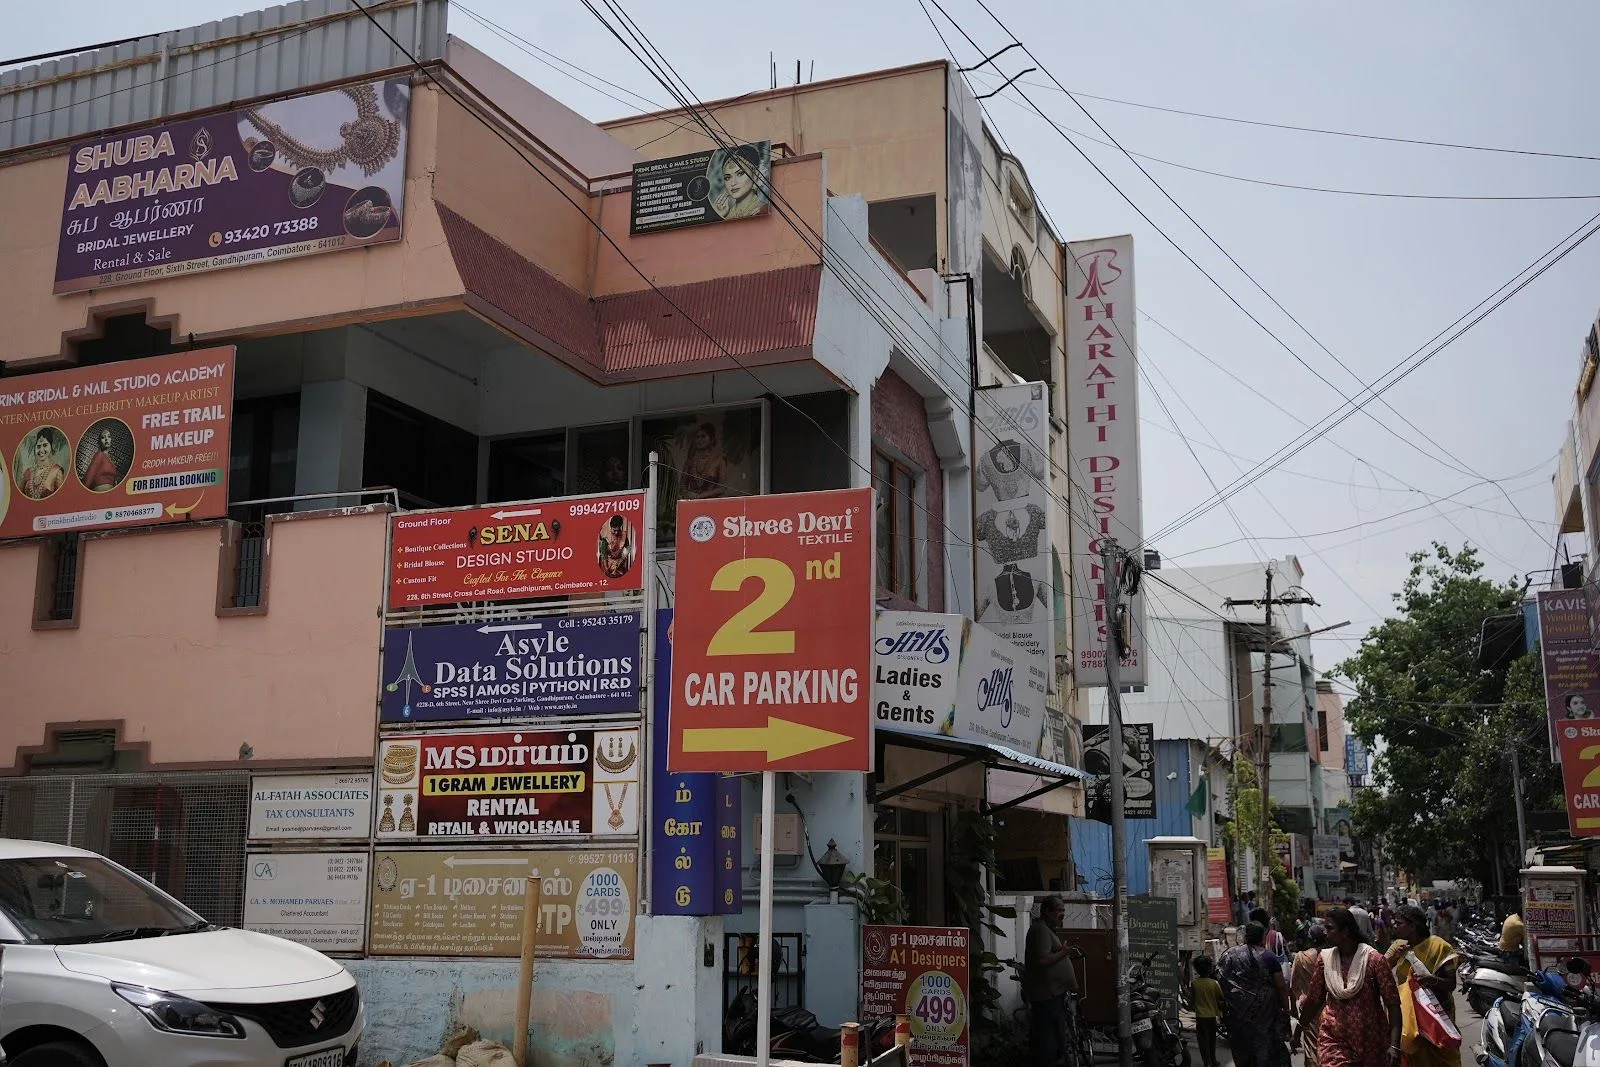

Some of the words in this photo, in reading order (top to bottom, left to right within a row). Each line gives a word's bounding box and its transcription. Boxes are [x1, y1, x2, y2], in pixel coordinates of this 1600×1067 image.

[74, 131, 175, 173] SHUBA
[68, 156, 238, 210] AABHARNA
[77, 233, 121, 254] BRIDAL
[122, 224, 194, 250] JEWELLERY
[225, 225, 269, 245] 93420
[273, 216, 318, 237] 73388
[93, 253, 131, 271] Rental
[133, 251, 143, 264] &
[147, 247, 171, 262] Sale
[115, 269, 141, 282] Ground
[143, 266, 164, 279] Floor,
[166, 261, 185, 275] Sixth
[186, 259, 210, 273] Street,
[212, 250, 263, 270] Gandhipuram,
[266, 243, 310, 260] Coimbatore
[0, 392, 25, 407] RINK
[28, 387, 69, 403] BRIDAL
[73, 384, 81, 398] &
[84, 382, 110, 397] NAIL
[113, 373, 160, 392] STUDIO
[164, 363, 225, 385] ACADEMY
[0, 408, 73, 425] TERNATIONAL
[76, 398, 134, 416] CELEBRITY
[136, 393, 178, 408] MAKEUP
[178, 386, 220, 402] ARTIST
[142, 411, 180, 429] FREE
[183, 404, 225, 424] TRAIL
[150, 428, 214, 451] MAKEUP
[142, 457, 166, 470] GROOM
[167, 454, 194, 466] MAKEUP
[133, 480, 148, 491] FOR
[149, 475, 178, 490] BRIDAL
[179, 472, 216, 486] BOOKING
[569, 499, 640, 517] 9994271009
[398, 519, 429, 529] Ground
[430, 517, 452, 527] Floor
[722, 515, 793, 539] Shree
[797, 508, 853, 534] Devi
[480, 522, 550, 546] SENA
[797, 533, 853, 546] TEXTILE
[404, 545, 432, 554] Boutique
[433, 541, 467, 552] Collections
[456, 552, 513, 569] DESIGN
[515, 546, 573, 564] STUDIO
[403, 561, 424, 569] Bridal
[424, 559, 445, 568] Blouse
[402, 576, 426, 585] Custom
[427, 575, 437, 583] Fit
[463, 573, 492, 587] Crafted
[531, 567, 563, 580] Elegance
[432, 591, 453, 600] Street,
[454, 589, 475, 598] Cross
[476, 588, 486, 596] Cut
[486, 587, 506, 597] Road,
[507, 584, 553, 596] Gandhipuram,
[554, 580, 593, 591] Coimbatore
[706, 557, 796, 656] 2
[806, 552, 841, 581] nd
[558, 619, 576, 629] Cell
[582, 616, 606, 628] 95243
[608, 614, 633, 625] 35179
[495, 630, 569, 660] Asyle
[1012, 632, 1033, 640] Blouse
[875, 629, 950, 665] Hills
[434, 662, 497, 685] Data
[505, 653, 633, 681] Solutions
[876, 665, 942, 689] Ladies
[433, 686, 468, 699] SPSS
[476, 683, 520, 697] AMOS
[530, 679, 592, 694] PYTHON
[600, 677, 631, 690] R&D
[684, 672, 735, 707] CAR
[743, 668, 858, 706] PARKING
[902, 690, 911, 701] &
[977, 666, 1014, 729] Hills
[877, 701, 935, 725] Gents
[423, 746, 477, 770] MS
[491, 774, 581, 791] JEWELLERY
[255, 791, 301, 801] AL-FATAH
[303, 789, 369, 800] ASSOCIATES
[265, 809, 283, 819] TAX
[286, 808, 355, 819] CONSULTANTS
[467, 798, 540, 817] RENTAL
[428, 821, 475, 835] RETAIL
[479, 821, 491, 835] &
[493, 820, 580, 835] WHOLESALE
[579, 854, 605, 865] 99527
[608, 852, 634, 864] 10113
[589, 873, 618, 887] 1000
[586, 887, 621, 897] CARDS
[537, 904, 572, 935] TP
[591, 919, 618, 930] ONLY
[889, 949, 906, 965] A1
[911, 950, 967, 970] Designers
[920, 975, 951, 989] 1000
[921, 988, 952, 996] CARDS
[925, 1024, 948, 1033] ONLY
